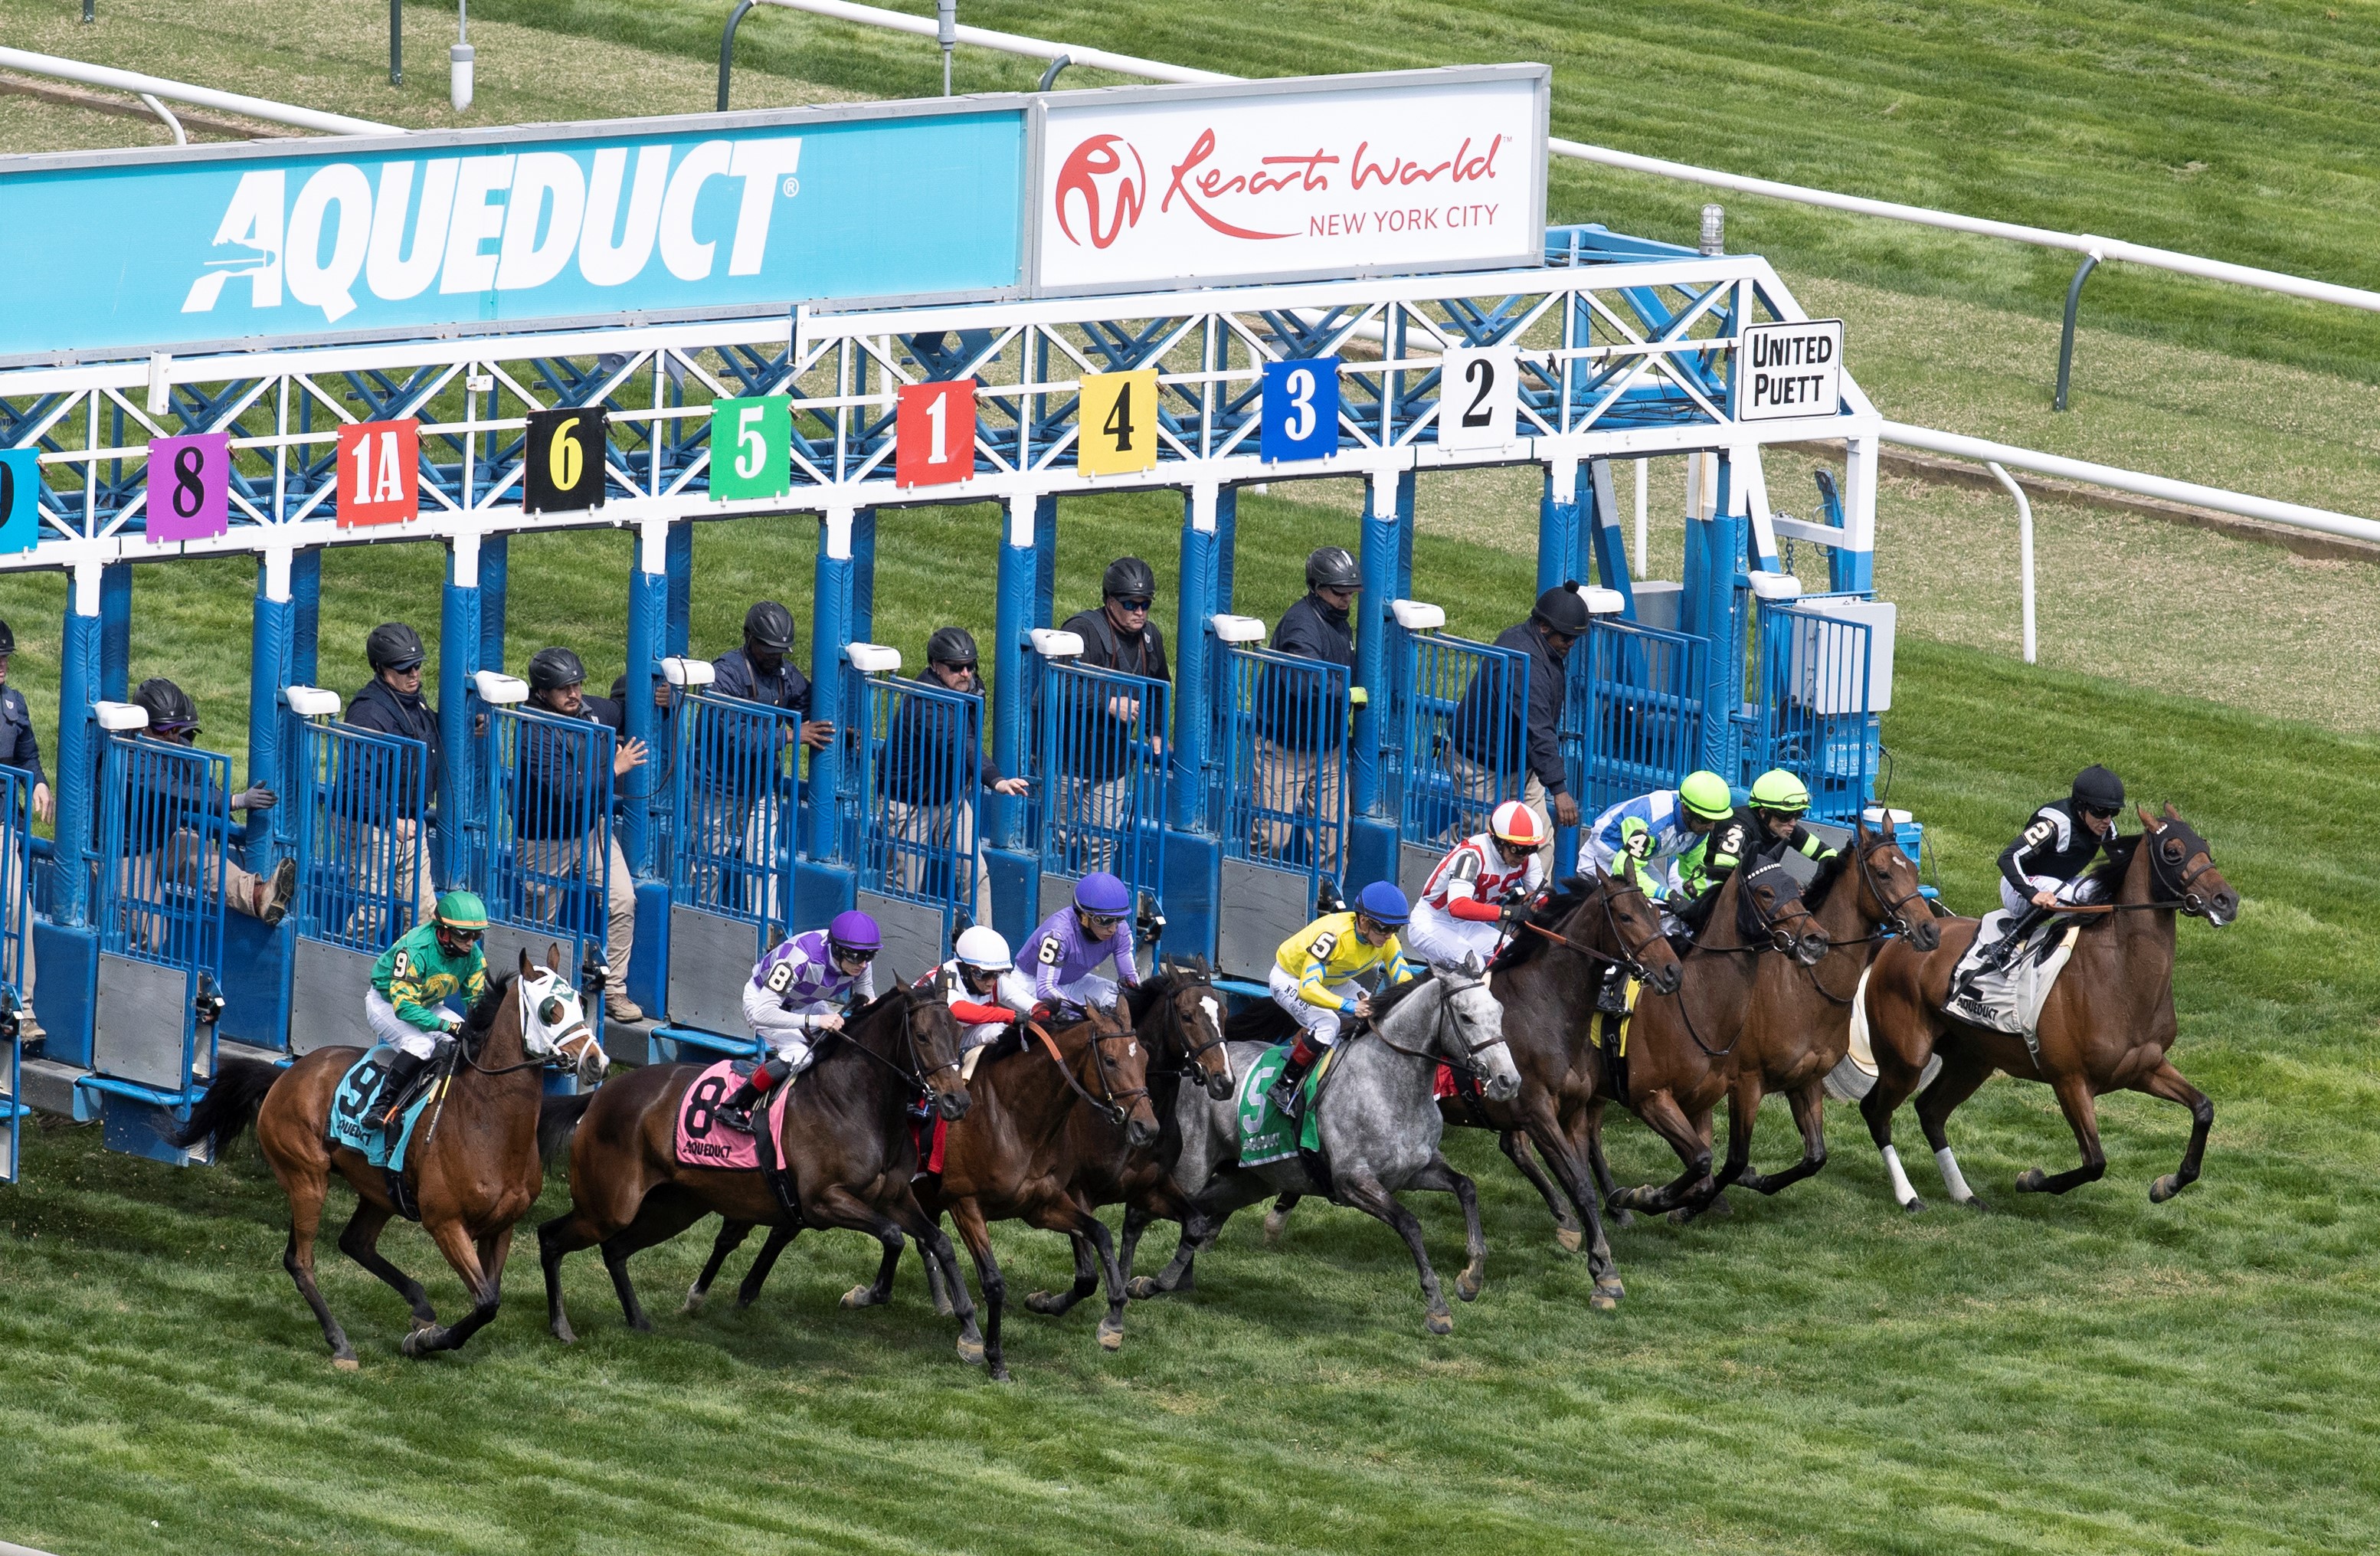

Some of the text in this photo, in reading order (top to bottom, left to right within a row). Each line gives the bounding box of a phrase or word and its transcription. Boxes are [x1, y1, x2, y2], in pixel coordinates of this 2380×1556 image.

[1161, 128, 1501, 240] Resorts World
[1309, 203, 1499, 237] NEW YORK CITY
[1103, 382, 1134, 452] 4
[1285, 369, 1317, 441] 3
[1462, 359, 1494, 427] 2
[549, 418, 584, 491] 6
[735, 405, 767, 479] 5
[926, 391, 948, 464] 1
[172, 446, 205, 519] 8
[352, 431, 404, 505] 1A
[1628, 834, 1647, 858] 4
[1721, 827, 1743, 854] 3
[2024, 821, 2050, 847] 2
[1460, 856, 1472, 880] 1
[393, 952, 408, 978] 9
[1039, 936, 1059, 964] 6
[1311, 932, 1335, 958] 5
[768, 964, 791, 991] 8
[1956, 997, 1999, 1021] AQUEDUCT
[339, 1060, 387, 1119] 9
[684, 1076, 727, 1139] 8
[1242, 1066, 1276, 1134] 5
[683, 1141, 732, 1158] AQUEDUCT
